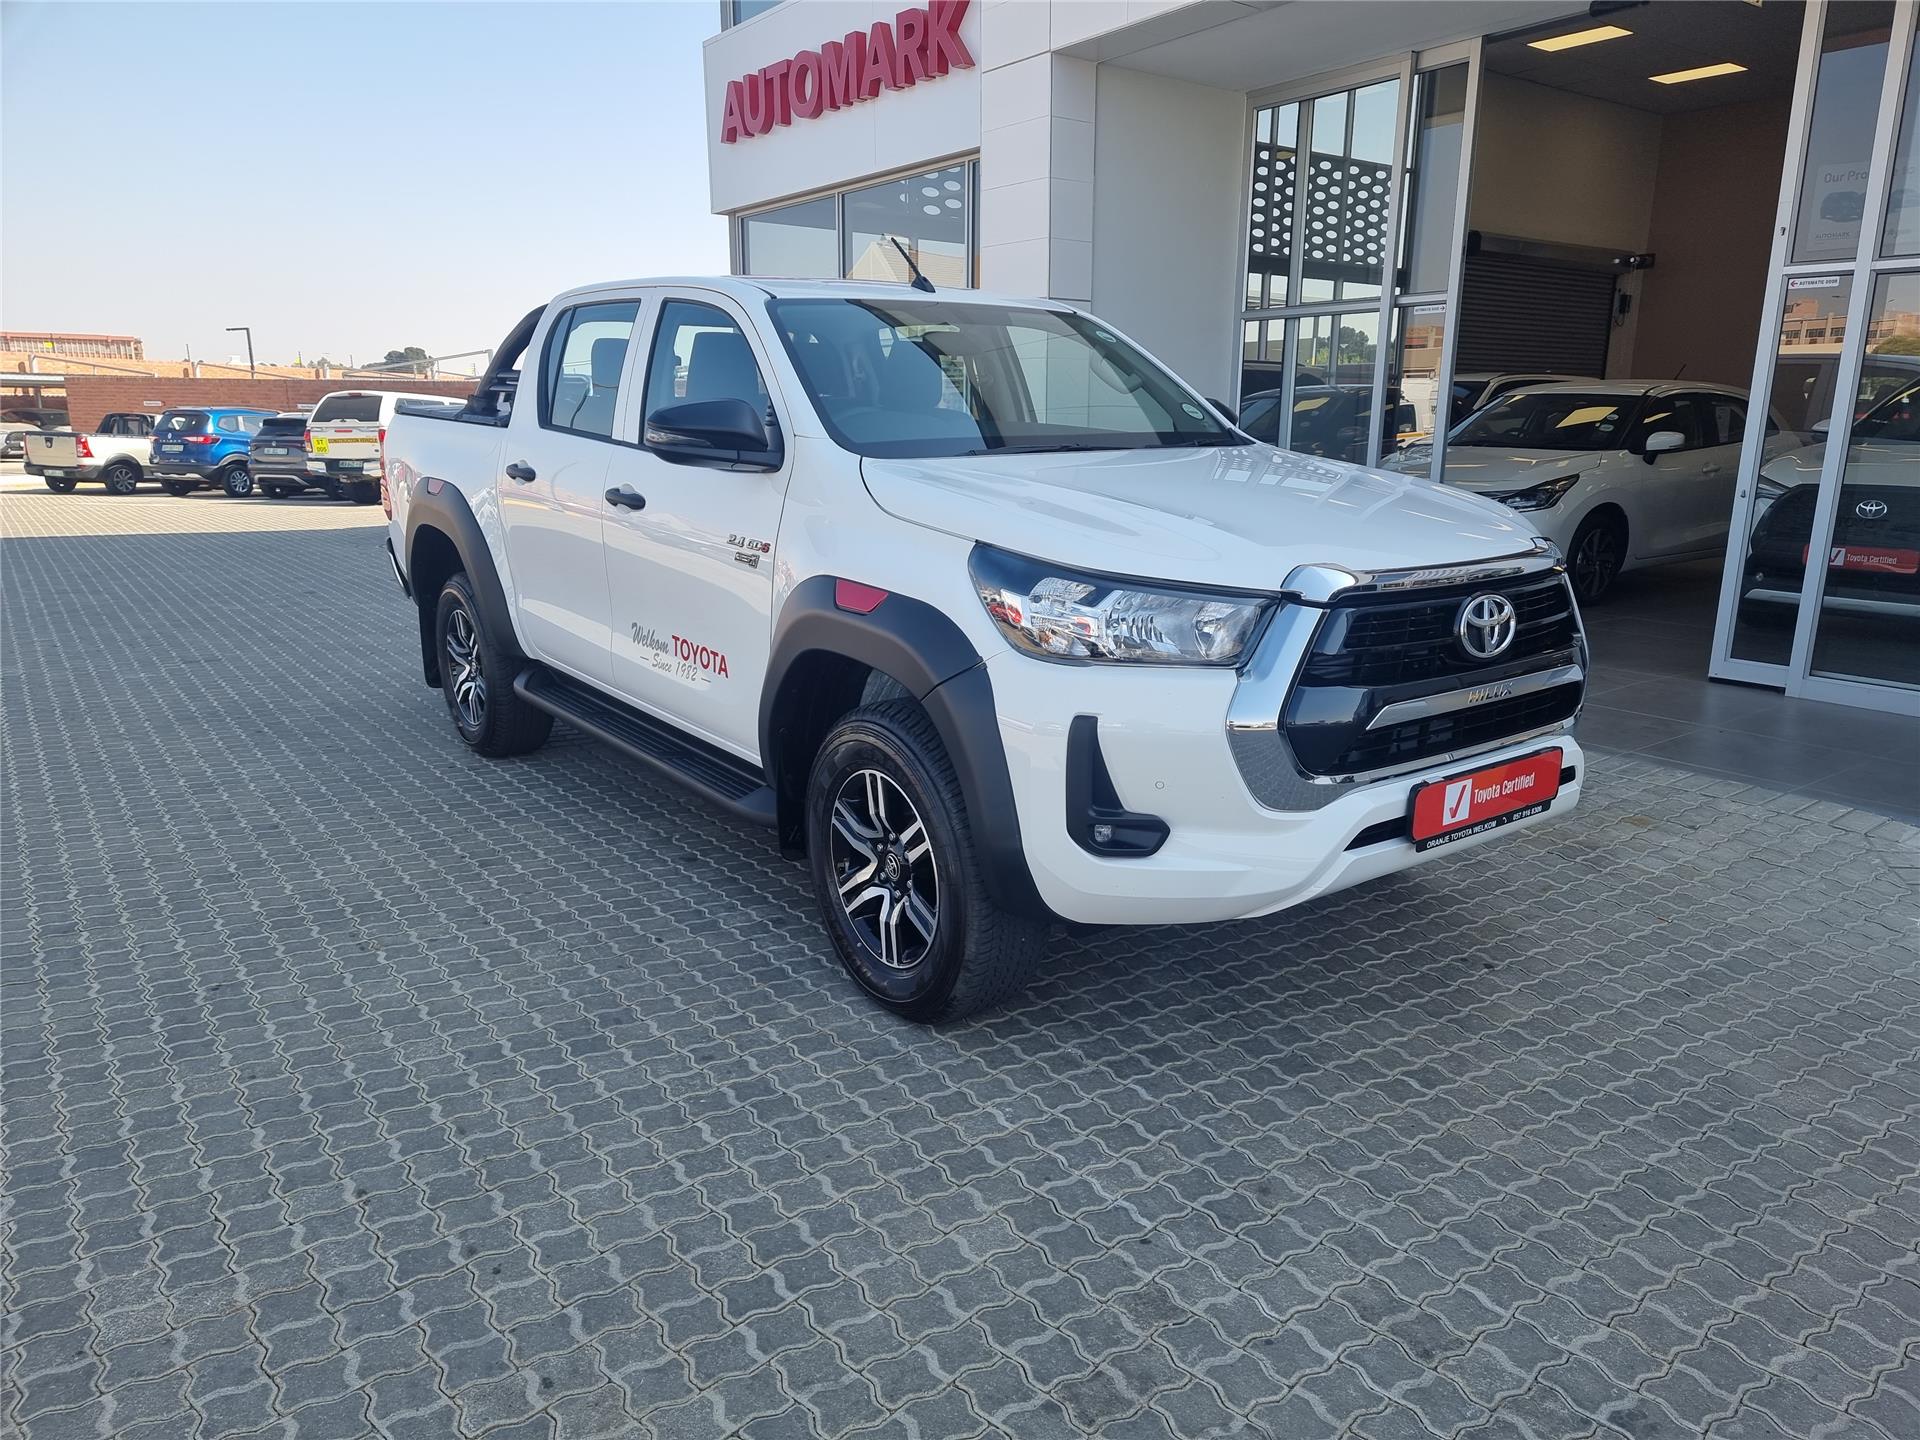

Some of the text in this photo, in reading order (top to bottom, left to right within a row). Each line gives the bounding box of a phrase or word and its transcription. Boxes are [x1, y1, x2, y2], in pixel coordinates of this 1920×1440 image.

[720, 0, 976, 144] AUTOMARK
[1846, 553, 1898, 565] Toyota Certified
[631, 622, 729, 679] Welkom TOYOTA
[651, 652, 698, 682] Since 1982
[1474, 772, 1535, 805] Toyota Certified
[1426, 834, 1451, 849] ORANJE
[1450, 828, 1473, 841] TOYOTA
[1473, 820, 1497, 834] WELKOM
